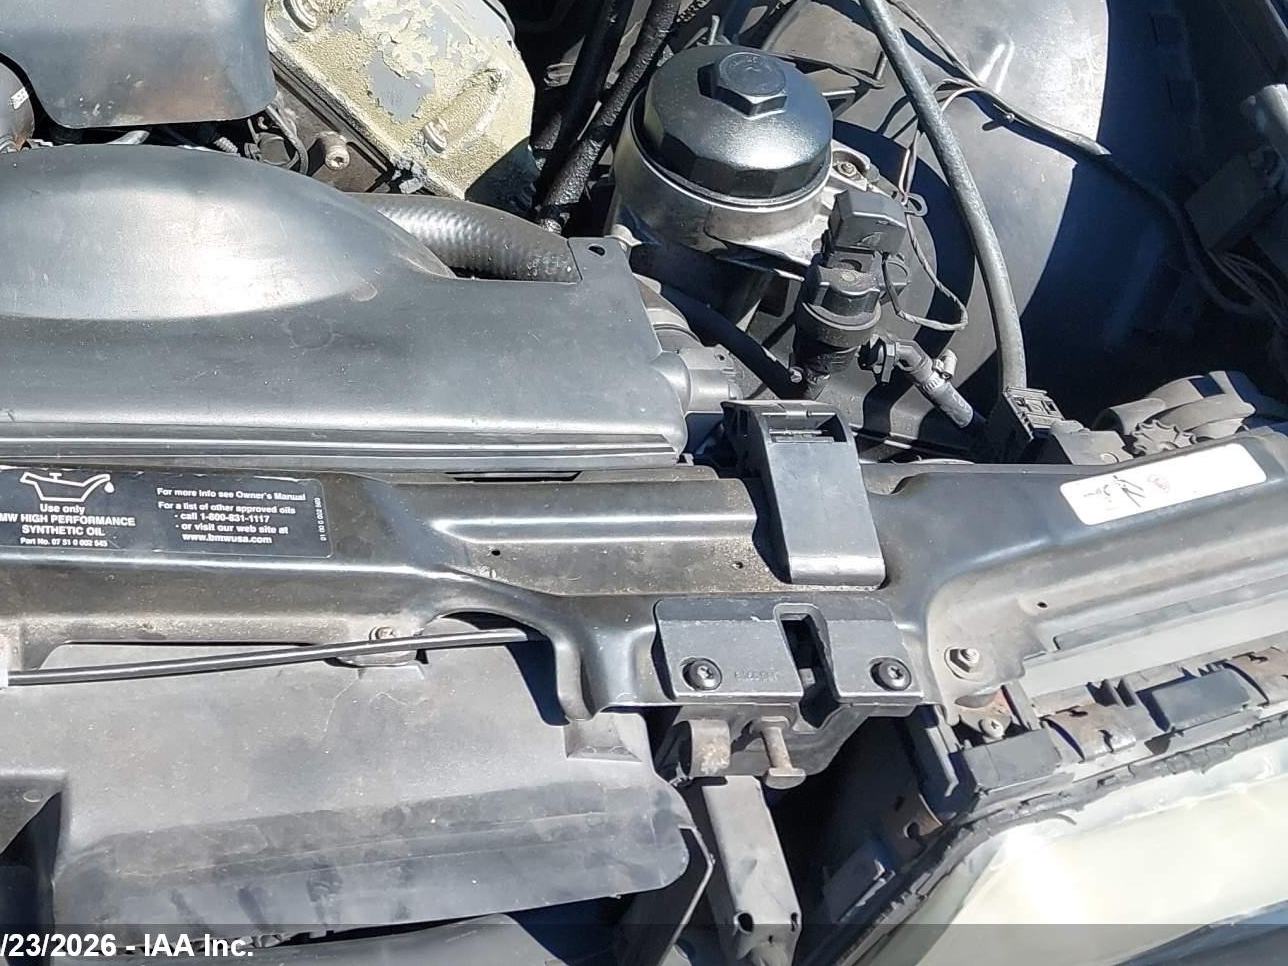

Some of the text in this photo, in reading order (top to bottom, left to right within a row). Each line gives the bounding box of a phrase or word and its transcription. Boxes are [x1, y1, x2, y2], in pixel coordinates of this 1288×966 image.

[157, 487, 306, 501] For more info see Owner's Manual
[40, 504, 85, 515] Use only
[158, 501, 174, 510] For
[183, 502, 198, 511] list
[199, 502, 209, 511] of
[210, 503, 234, 512] other
[236, 505, 278, 515] approved
[279, 505, 296, 514] oils
[21, 514, 48, 524] HIGH
[51, 515, 136, 527] PERFORMANCE
[180, 512, 271, 524] call 1-800-831-1117
[22, 524, 106, 537] SYNTHETIC OIL
[181, 522, 289, 535] or visit our web site at
[20, 537, 37, 545] Part
[37, 538, 51, 546] No.
[51, 538, 61, 546] 07
[182, 533, 273, 545] www.bmwusa.com
